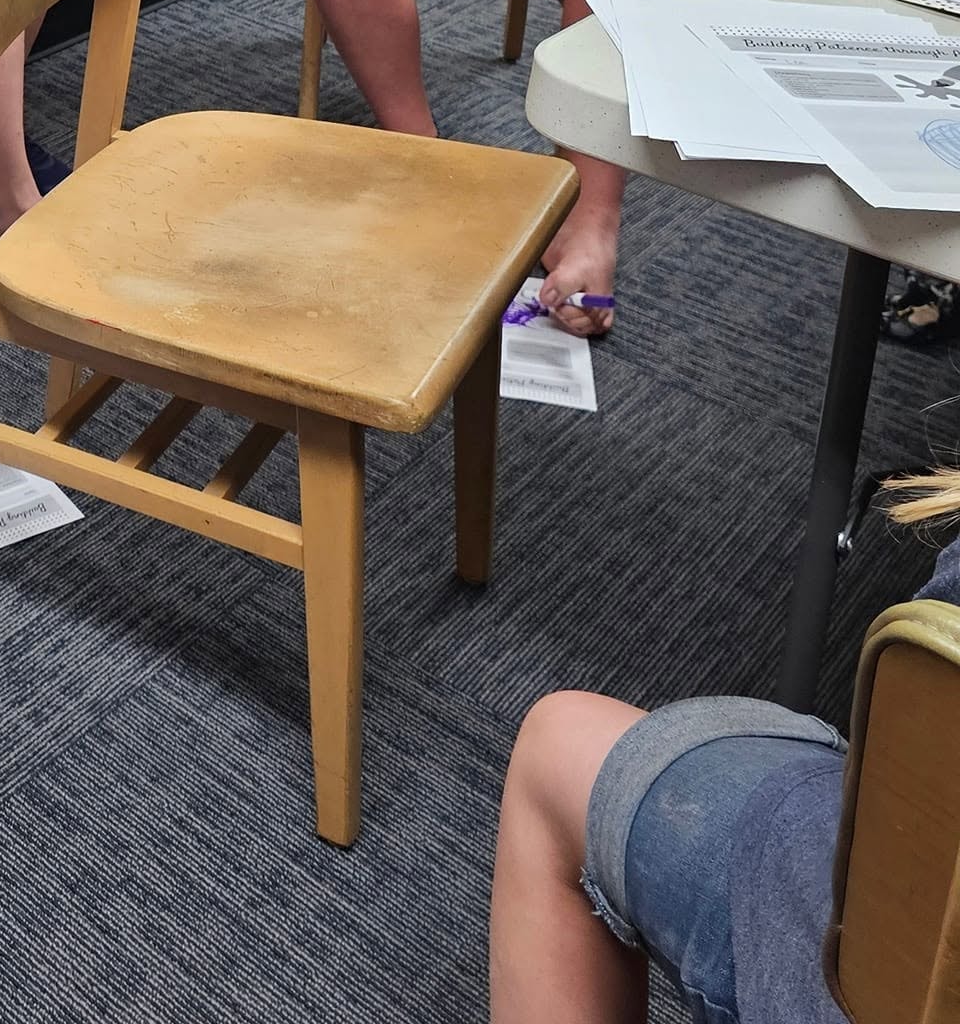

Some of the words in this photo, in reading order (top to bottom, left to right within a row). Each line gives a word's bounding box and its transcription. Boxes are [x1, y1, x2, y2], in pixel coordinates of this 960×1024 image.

[743, 38, 813, 52] Building
[815, 41, 881, 53] Patience
[884, 46, 947, 59] through
[6, 502, 47, 520] Building
